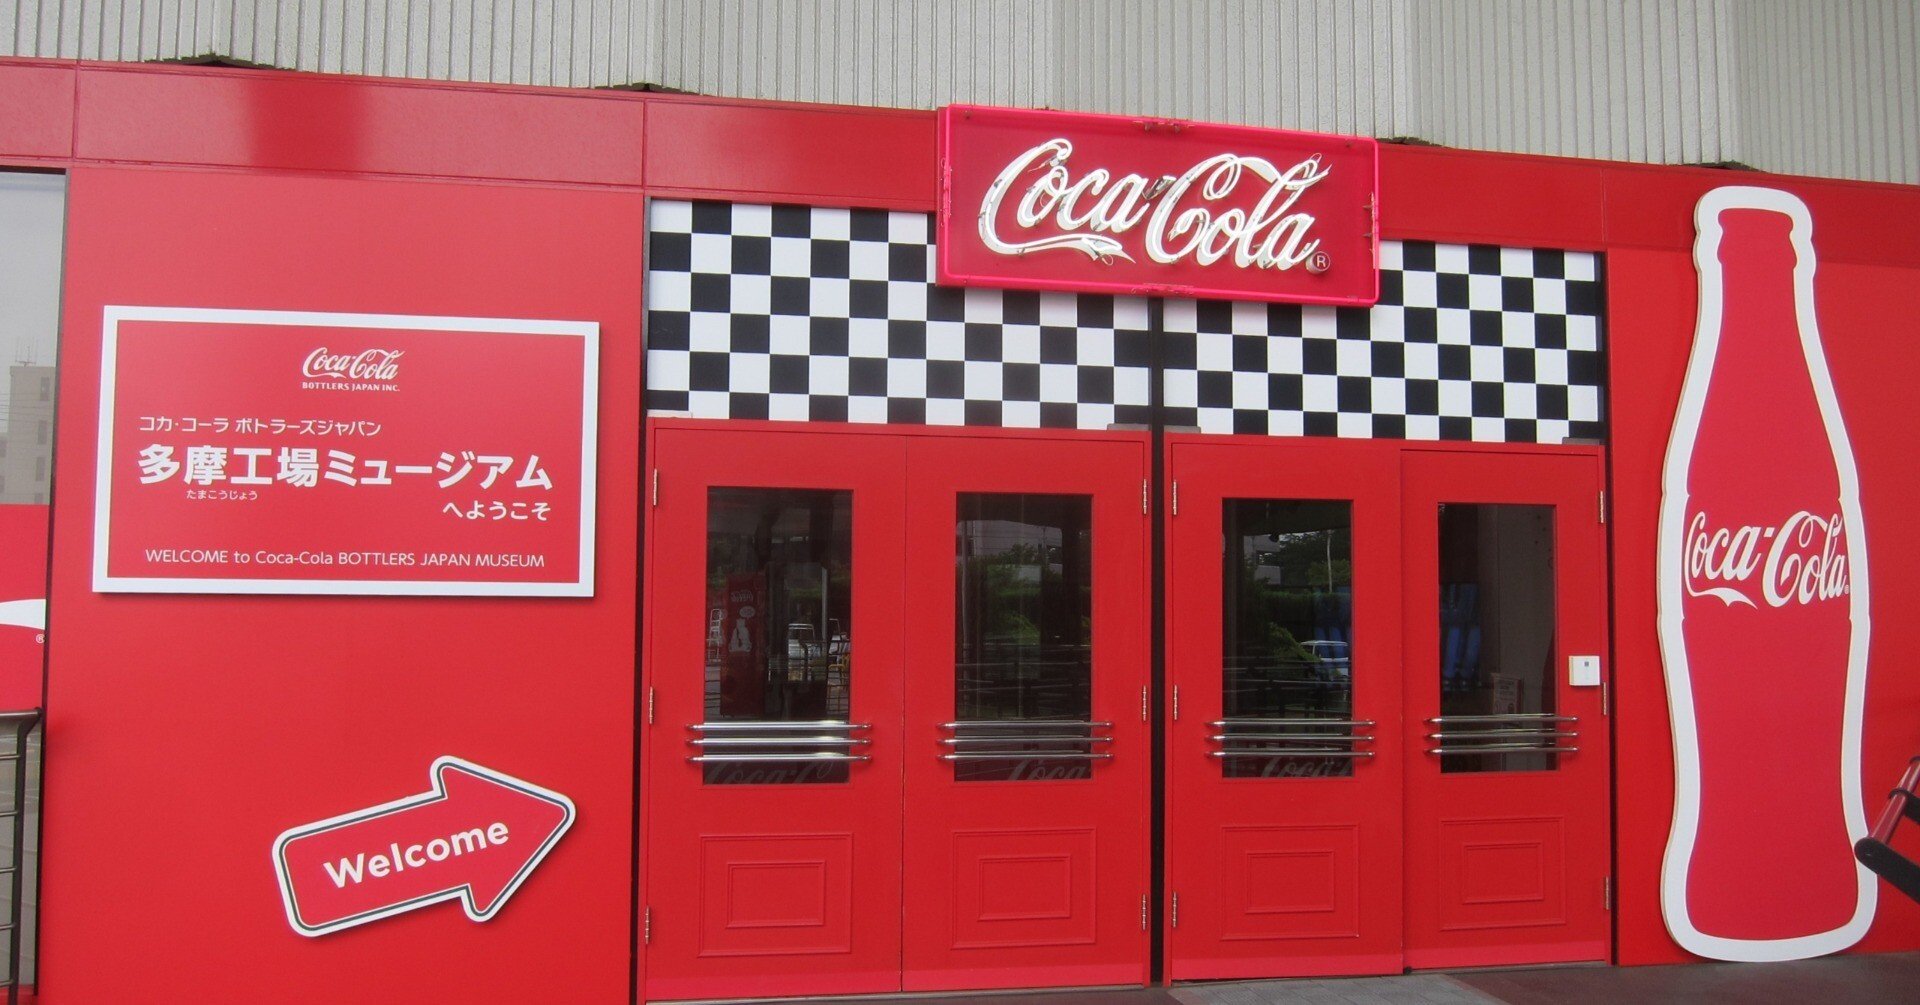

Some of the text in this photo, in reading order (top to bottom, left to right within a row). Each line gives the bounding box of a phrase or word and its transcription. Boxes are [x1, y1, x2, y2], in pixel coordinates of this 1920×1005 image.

[978, 138, 1333, 272] Coca-Cola
[302, 347, 405, 380] Coca-Cola
[302, 382, 349, 391] BOTTLERS
[351, 383, 380, 391] JAPAN
[235, 418, 382, 437] ボトラーズジャパン
[138, 443, 553, 491] 多摩工場ミュージアム
[186, 489, 259, 501] たまこうじょう
[442, 500, 551, 521] へようこそ
[145, 549, 545, 568] WELCOME to Coca-Cola BOTTLERS JAPAN MUSEUM
[1684, 511, 1847, 609] Coca-Cola
[323, 822, 509, 888] Welcome
